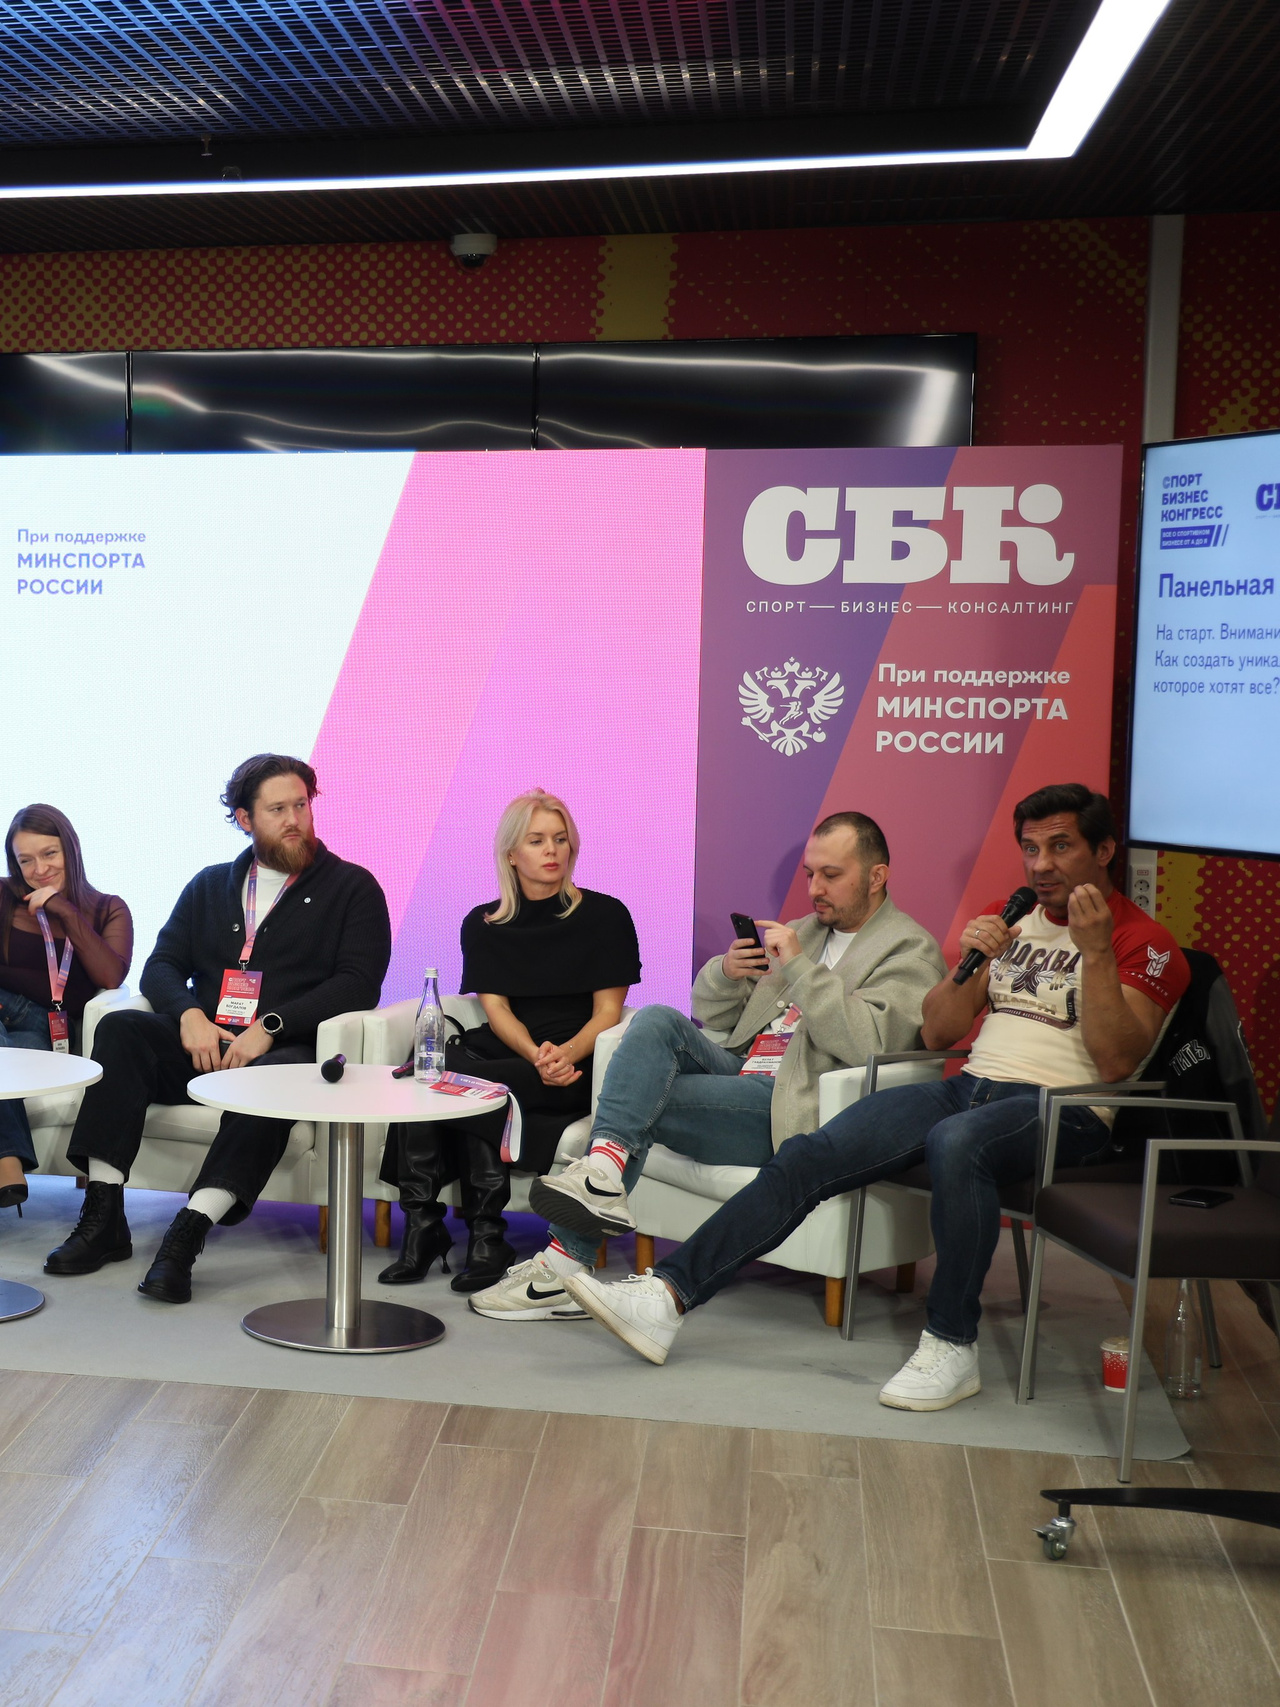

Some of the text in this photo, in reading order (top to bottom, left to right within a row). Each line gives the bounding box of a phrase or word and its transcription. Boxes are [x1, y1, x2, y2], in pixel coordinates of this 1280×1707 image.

[1162, 473, 1202, 489] СПОРТ
[1161, 490, 1209, 506] БИЗНЕС
[1255, 483, 1280, 512] С
[1160, 506, 1223, 522] КОНГРЕСС
[17, 528, 147, 546] При поддержке
[742, 483, 1075, 586] СБК
[17, 553, 146, 569] МИНСПОРТА
[17, 579, 103, 595] РОССИИ
[1159, 573, 1275, 598] Панельная
[746, 600, 1074, 614] СПОРТ БИЗНЕС КОНСАЛТИНГ
[1156, 624, 1173, 641] На
[1177, 628, 1215, 644] старт.
[1155, 650, 1280, 671] Как создать уника
[878, 664, 1071, 688] При поддержке
[1153, 677, 1280, 697] которое хотят все?
[877, 697, 1068, 720] МИНСПОРТА
[876, 731, 1004, 754] РОССИИ
